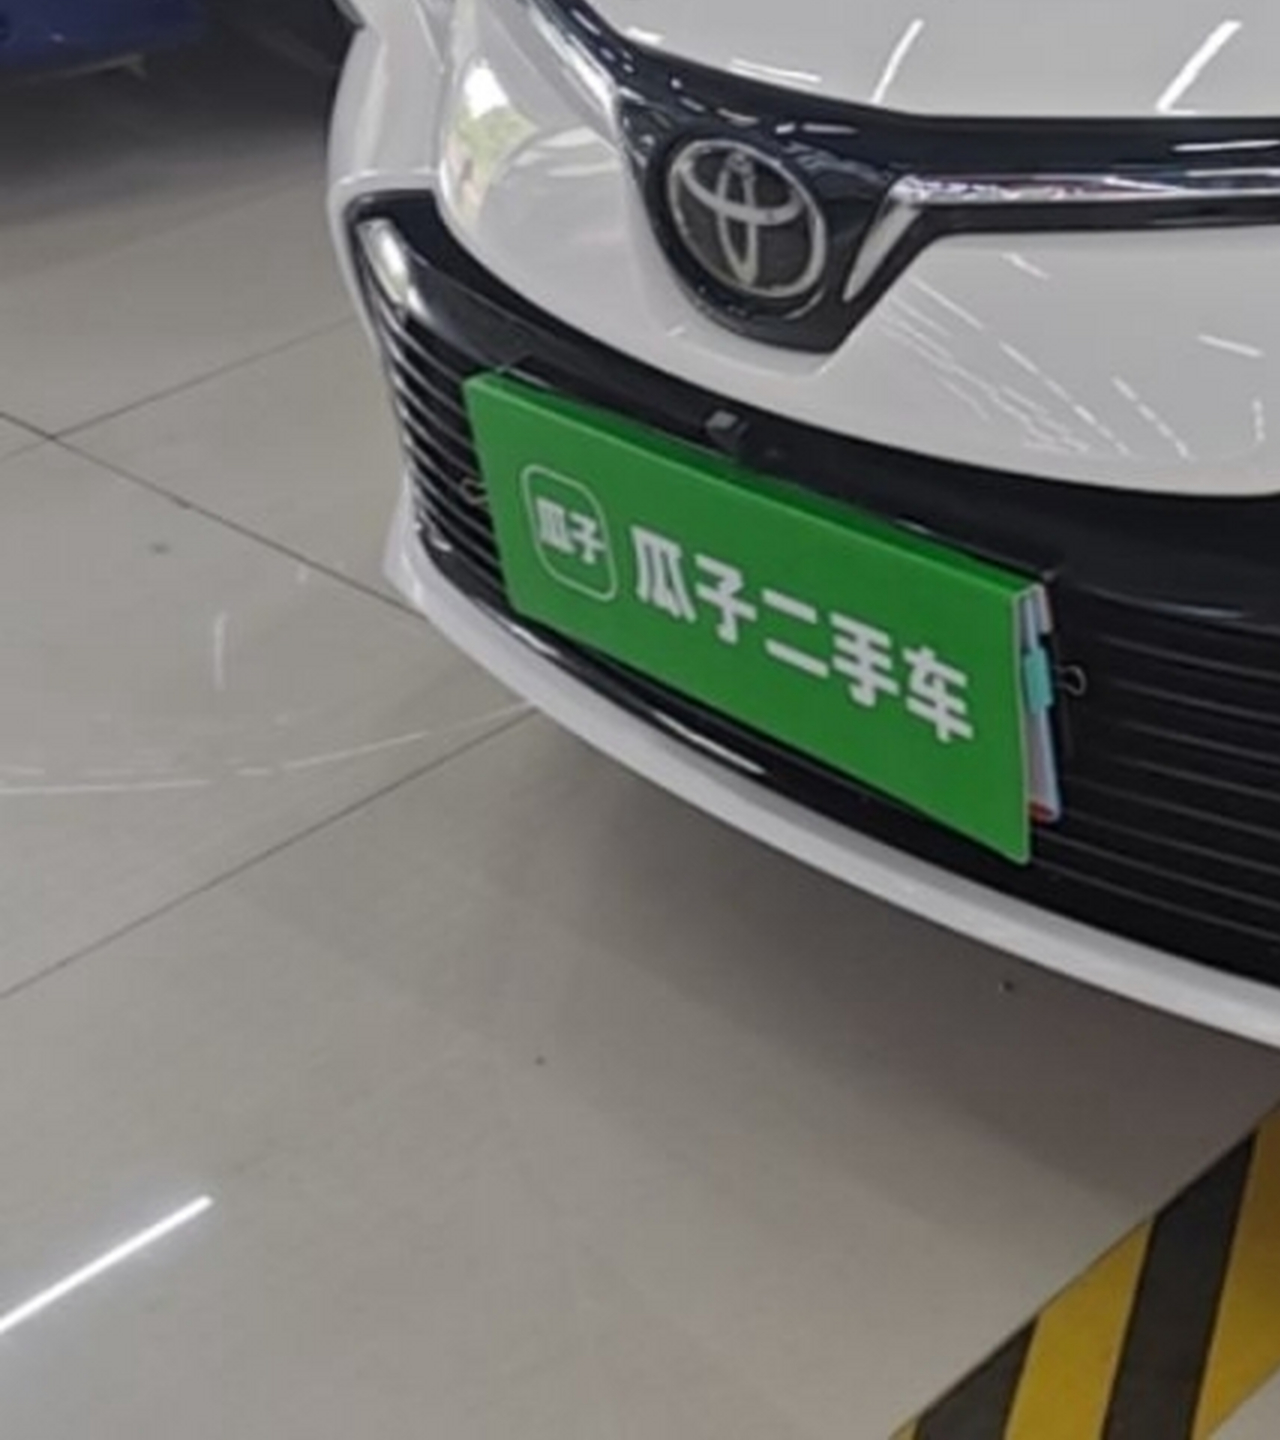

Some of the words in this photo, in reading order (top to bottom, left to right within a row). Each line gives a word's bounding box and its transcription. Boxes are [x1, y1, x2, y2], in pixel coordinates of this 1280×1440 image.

[535, 496, 605, 564] 瓜子
[630, 524, 974, 744] 瓜子二手车
